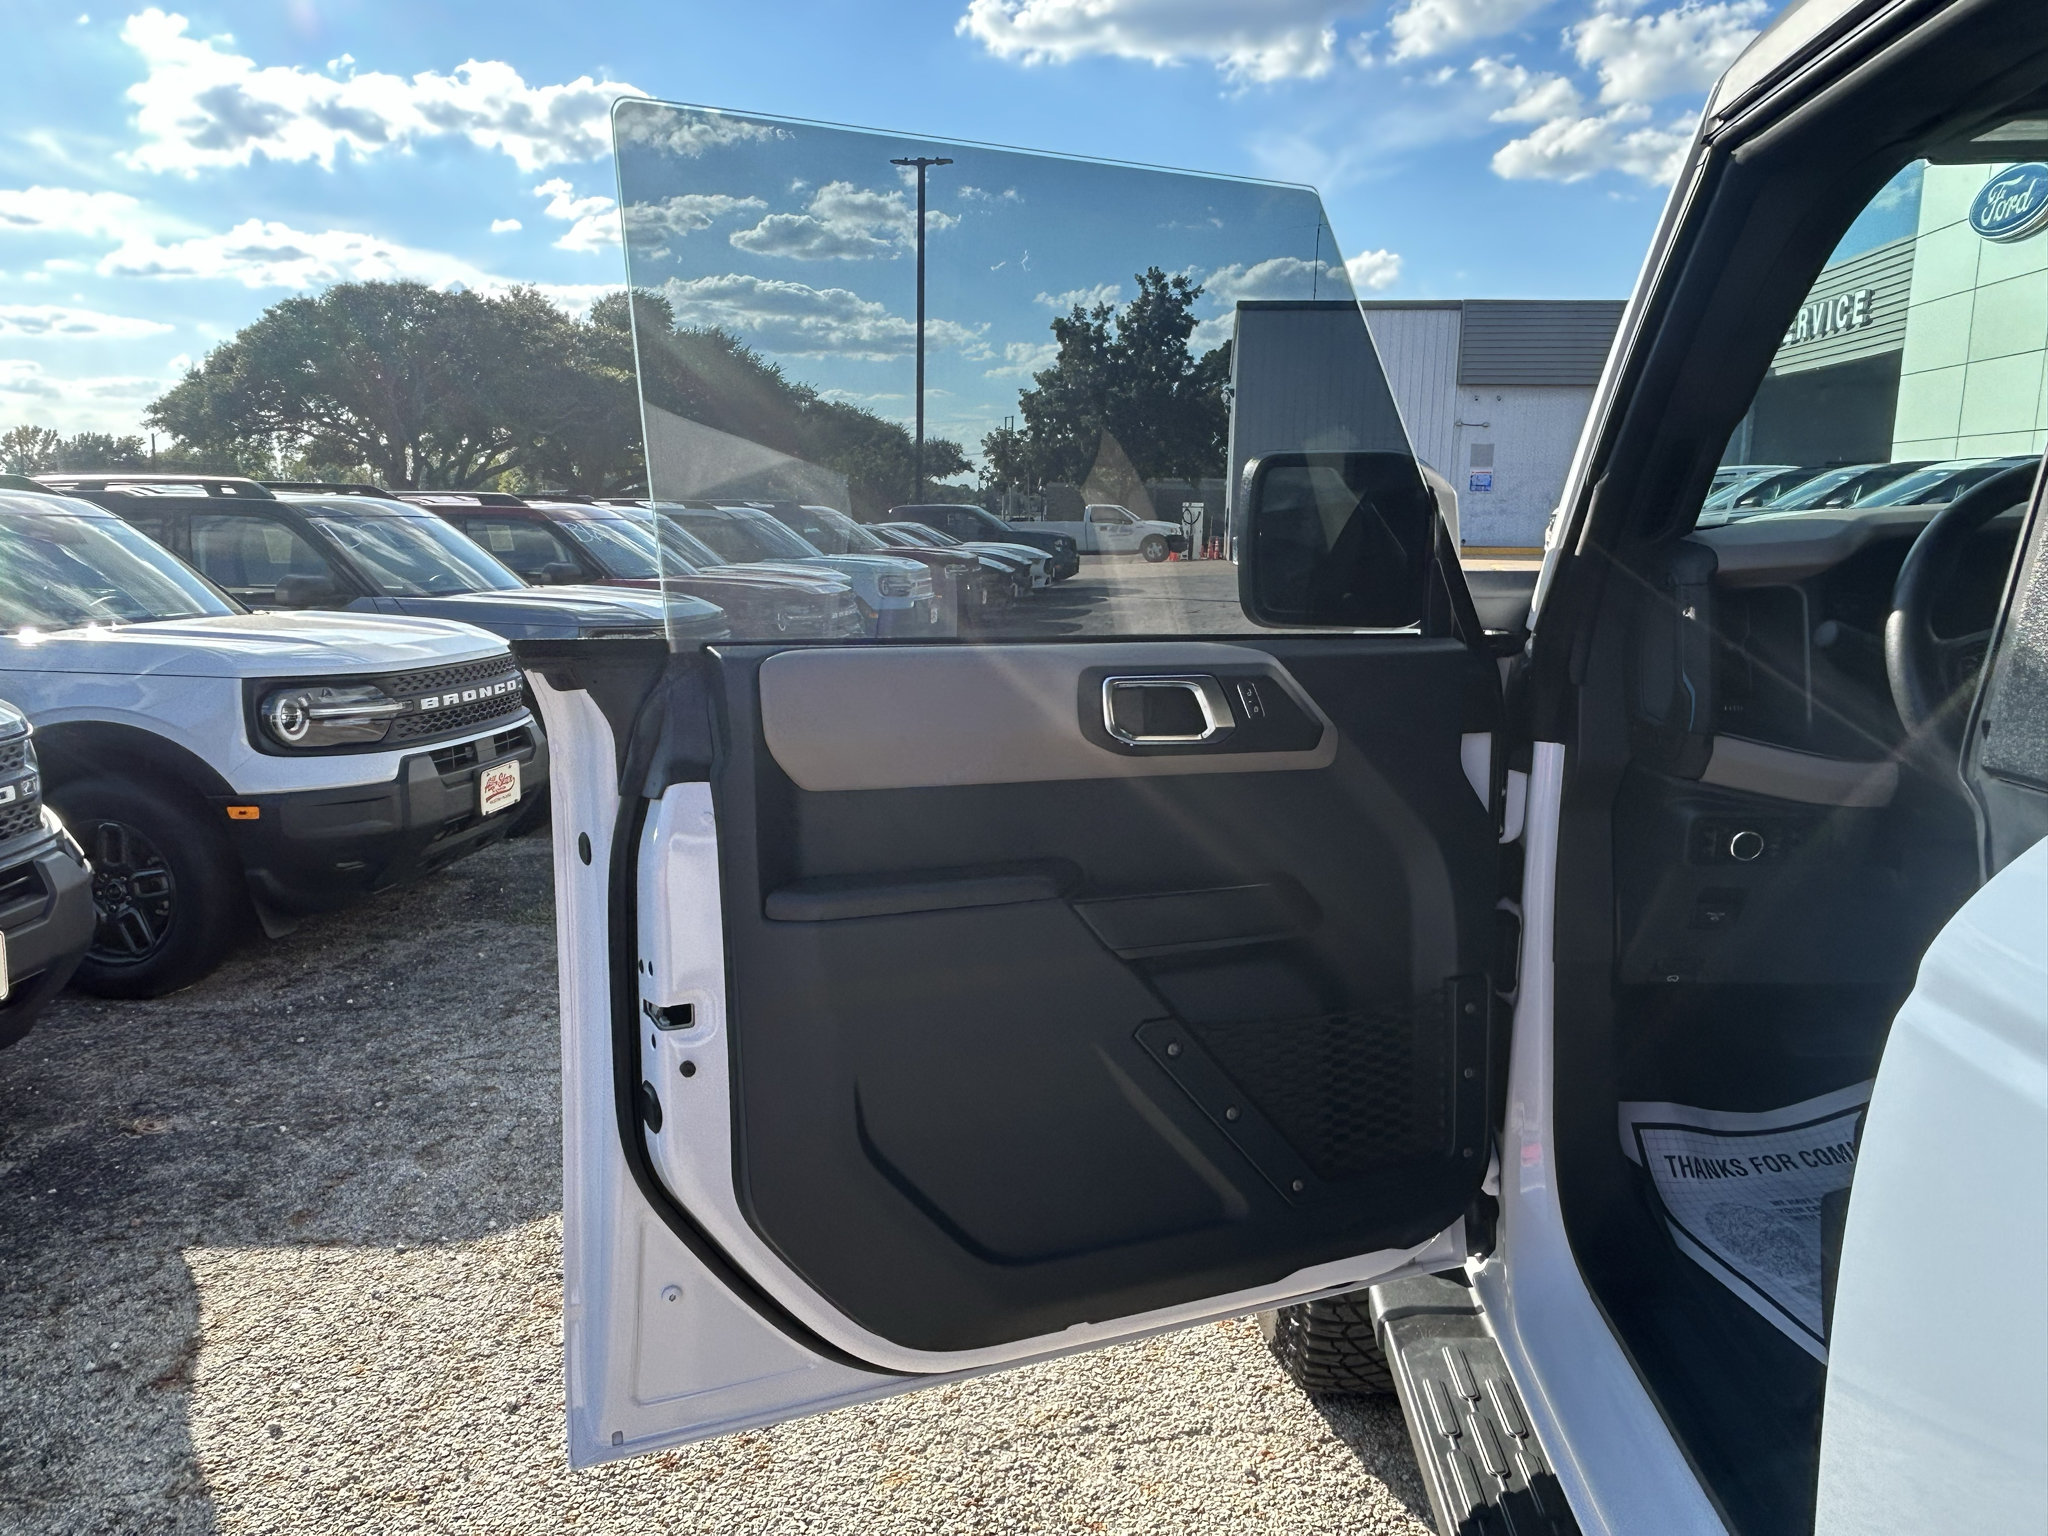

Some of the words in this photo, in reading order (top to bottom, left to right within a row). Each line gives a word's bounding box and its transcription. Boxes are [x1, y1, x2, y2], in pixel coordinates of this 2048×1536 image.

[1981, 174, 2039, 226] Ford
[421, 680, 517, 709] BRONCO
[1664, 1155, 1749, 1179] THANKS
[1749, 1154, 1800, 1174] FOR
